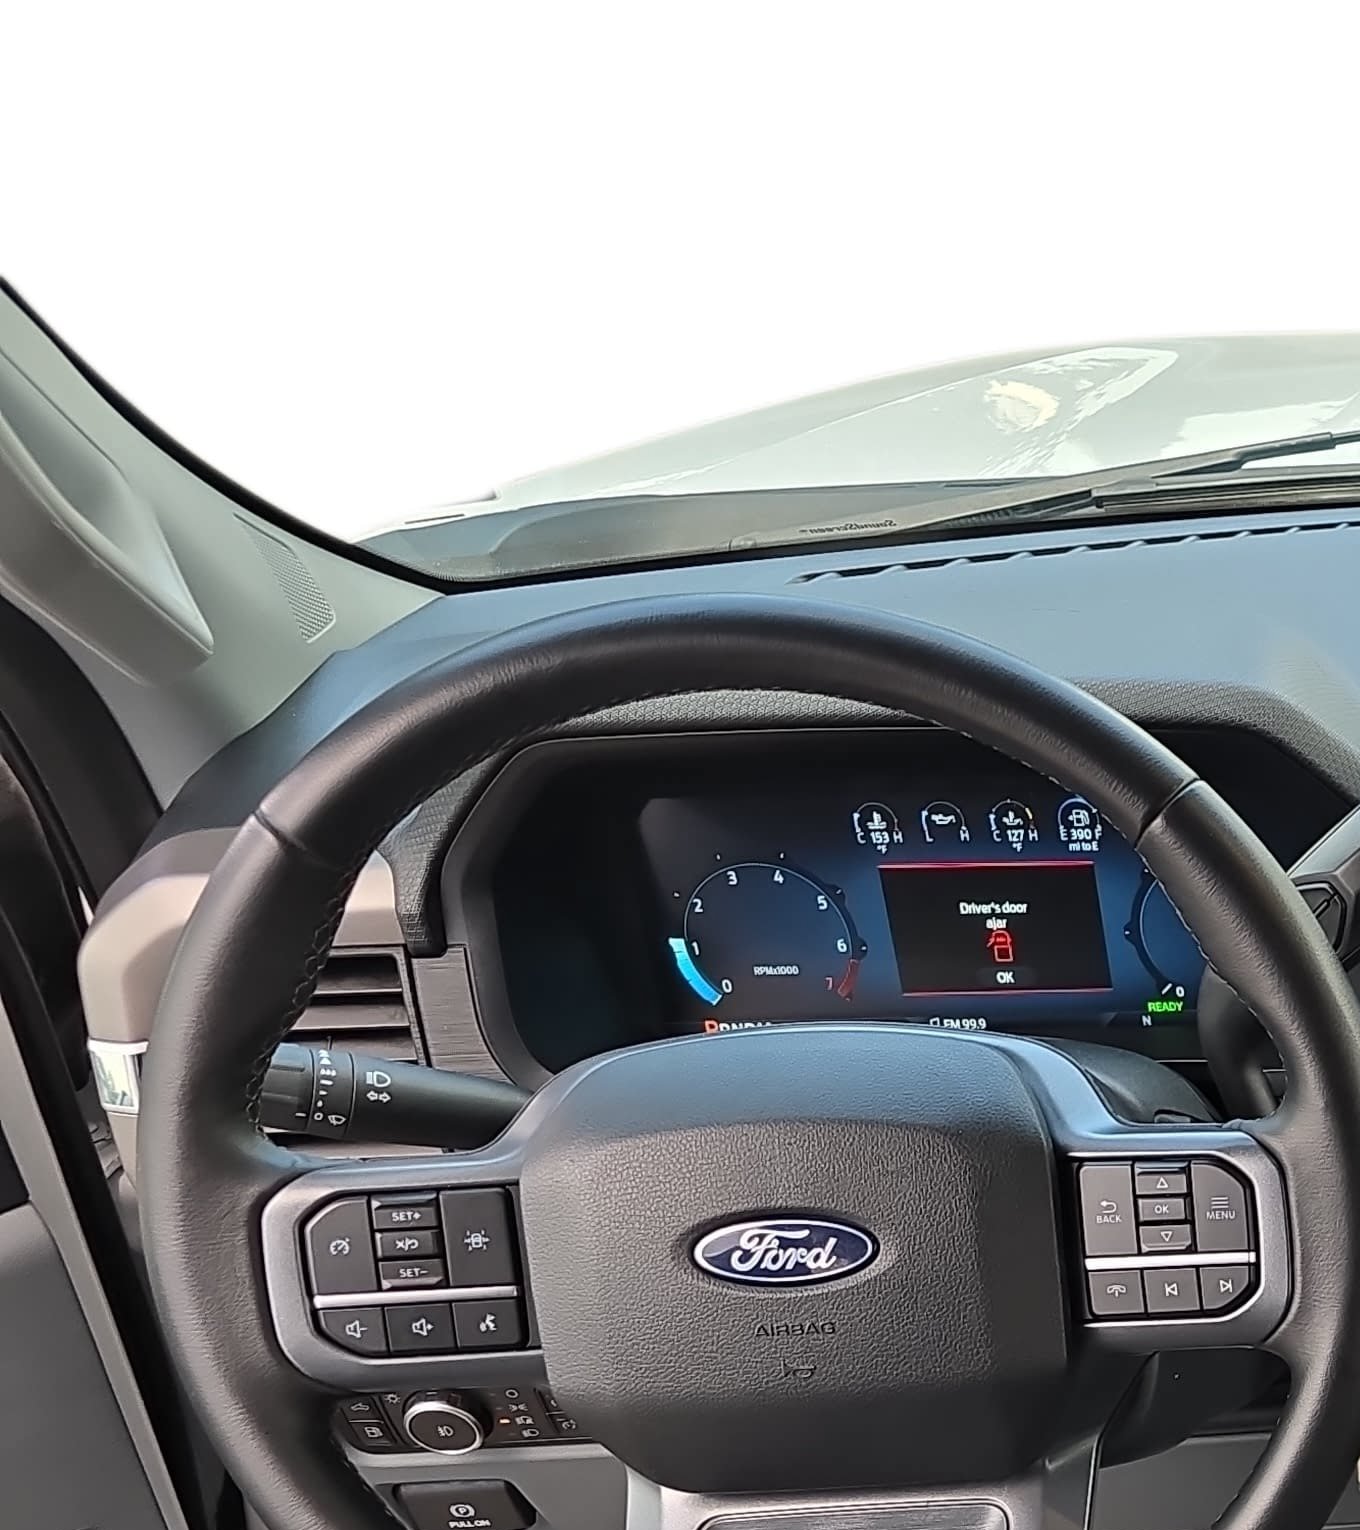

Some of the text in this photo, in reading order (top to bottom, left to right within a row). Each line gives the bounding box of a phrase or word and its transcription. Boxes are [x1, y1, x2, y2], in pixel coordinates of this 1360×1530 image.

[870, 831, 890, 844] 153
[893, 831, 904, 844] H
[960, 830, 970, 842] H
[1006, 829, 1025, 842] 127
[1028, 830, 1039, 842] H
[1070, 828, 1092, 840] 390
[726, 871, 738, 886] 3
[773, 870, 785, 884] 4
[693, 899, 704, 913] 2
[816, 895, 828, 910] 5
[959, 901, 1028, 915] Driver's door
[986, 917, 1007, 930] ajar
[692, 942, 700, 955] 1
[836, 939, 848, 953] 6
[824, 977, 833, 990] 7
[996, 971, 1015, 984] OK
[721, 979, 733, 993] 0
[1175, 986, 1185, 997] 0
[1148, 1001, 1183, 1013] READY
[943, 1018, 987, 1030] FM 99.9
[1142, 1015, 1152, 1027] N
[1154, 1204, 1169, 1214] OK
[1206, 1210, 1236, 1220] MENU
[1096, 1214, 1122, 1224] BACK
[730, 1228, 839, 1272] Ford
[755, 1321, 836, 1338] AIRBAG
[448, 1520, 475, 1530] PULL
